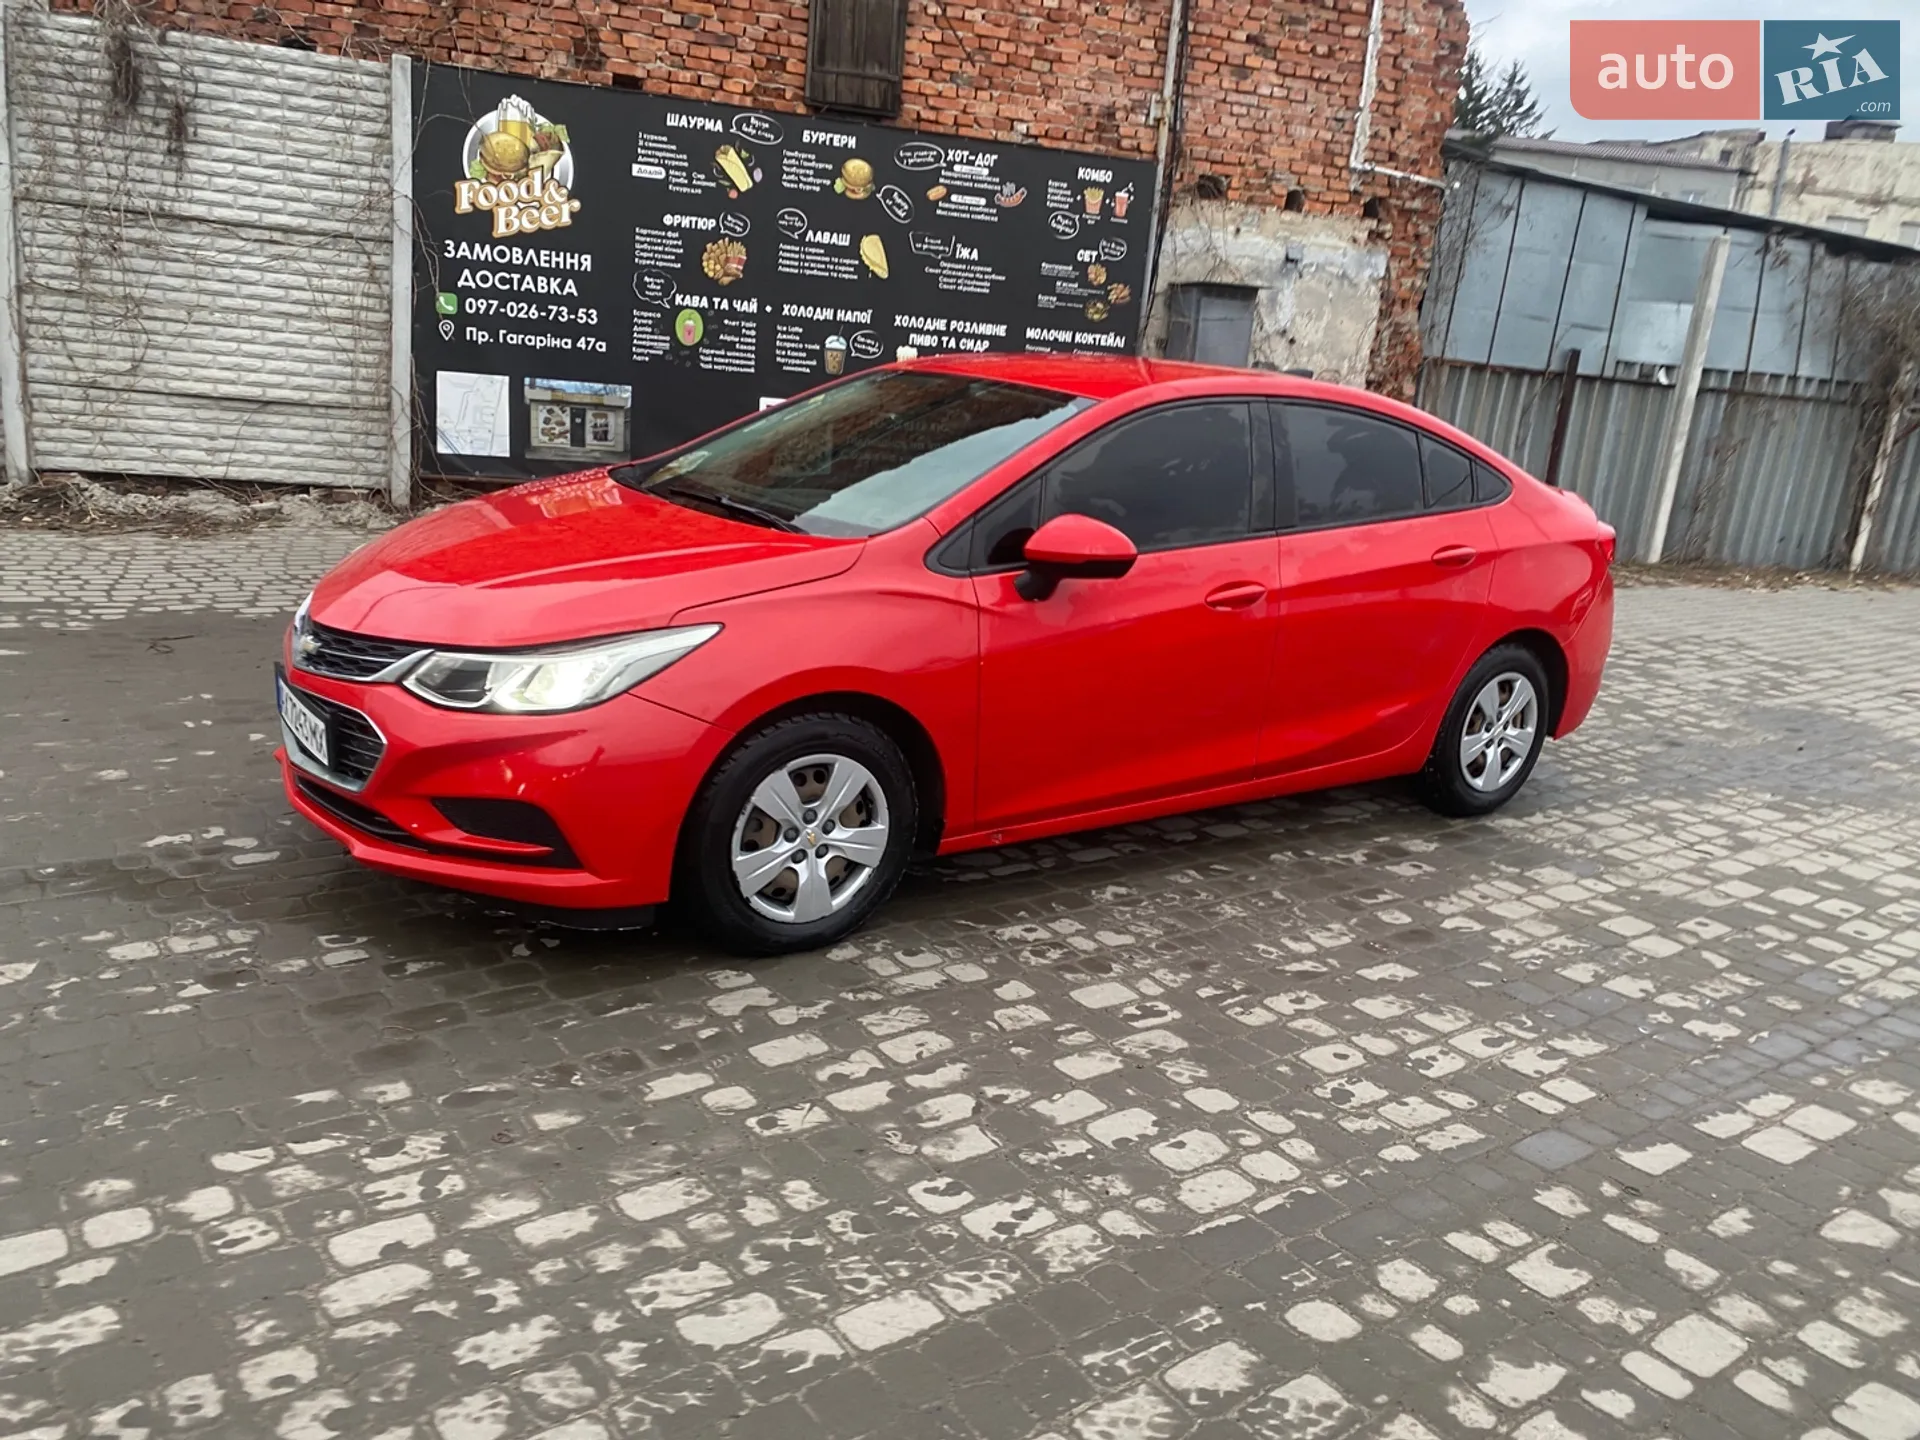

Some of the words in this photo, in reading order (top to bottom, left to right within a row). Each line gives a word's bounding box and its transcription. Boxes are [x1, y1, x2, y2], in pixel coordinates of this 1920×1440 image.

[666, 112, 723, 133] ШАУРМА
[802, 129, 857, 149] БУРГЕРИ
[946, 149, 998, 167] ХОТ-ДОГ
[1077, 167, 1113, 183] КОМБО
[455, 163, 544, 214] Food
[492, 198, 581, 238] Beer
[663, 213, 717, 231] ФРИТЮР
[805, 230, 850, 246] ЛАВАШ
[443, 239, 592, 272] ЗАМОВЛЕННЯ
[955, 243, 979, 261] ЇЖА
[1076, 249, 1098, 263] СЕТ
[458, 268, 578, 297] ДОСТАВКА
[465, 298, 598, 325] 097-026-73-53
[675, 293, 708, 309] КАВА
[712, 297, 729, 311] ТА
[732, 298, 758, 314] ЧАЙ
[782, 303, 834, 321] ХОЛОДНІ
[836, 308, 873, 324] НАПОЇ
[893, 314, 947, 331] ХОЛОДНЕ
[950, 320, 1007, 337] РОЗЛИВНЕ
[466, 327, 494, 345] Пр.
[498, 330, 572, 349] Гагаріна
[576, 336, 607, 352] 47а
[908, 333, 939, 347] ПИВО
[941, 336, 957, 349] ТА
[959, 337, 990, 353] СИДР
[1025, 327, 1072, 341] МОЛОЧНІ
[1074, 330, 1126, 348] КОКТЕЙЛІ
